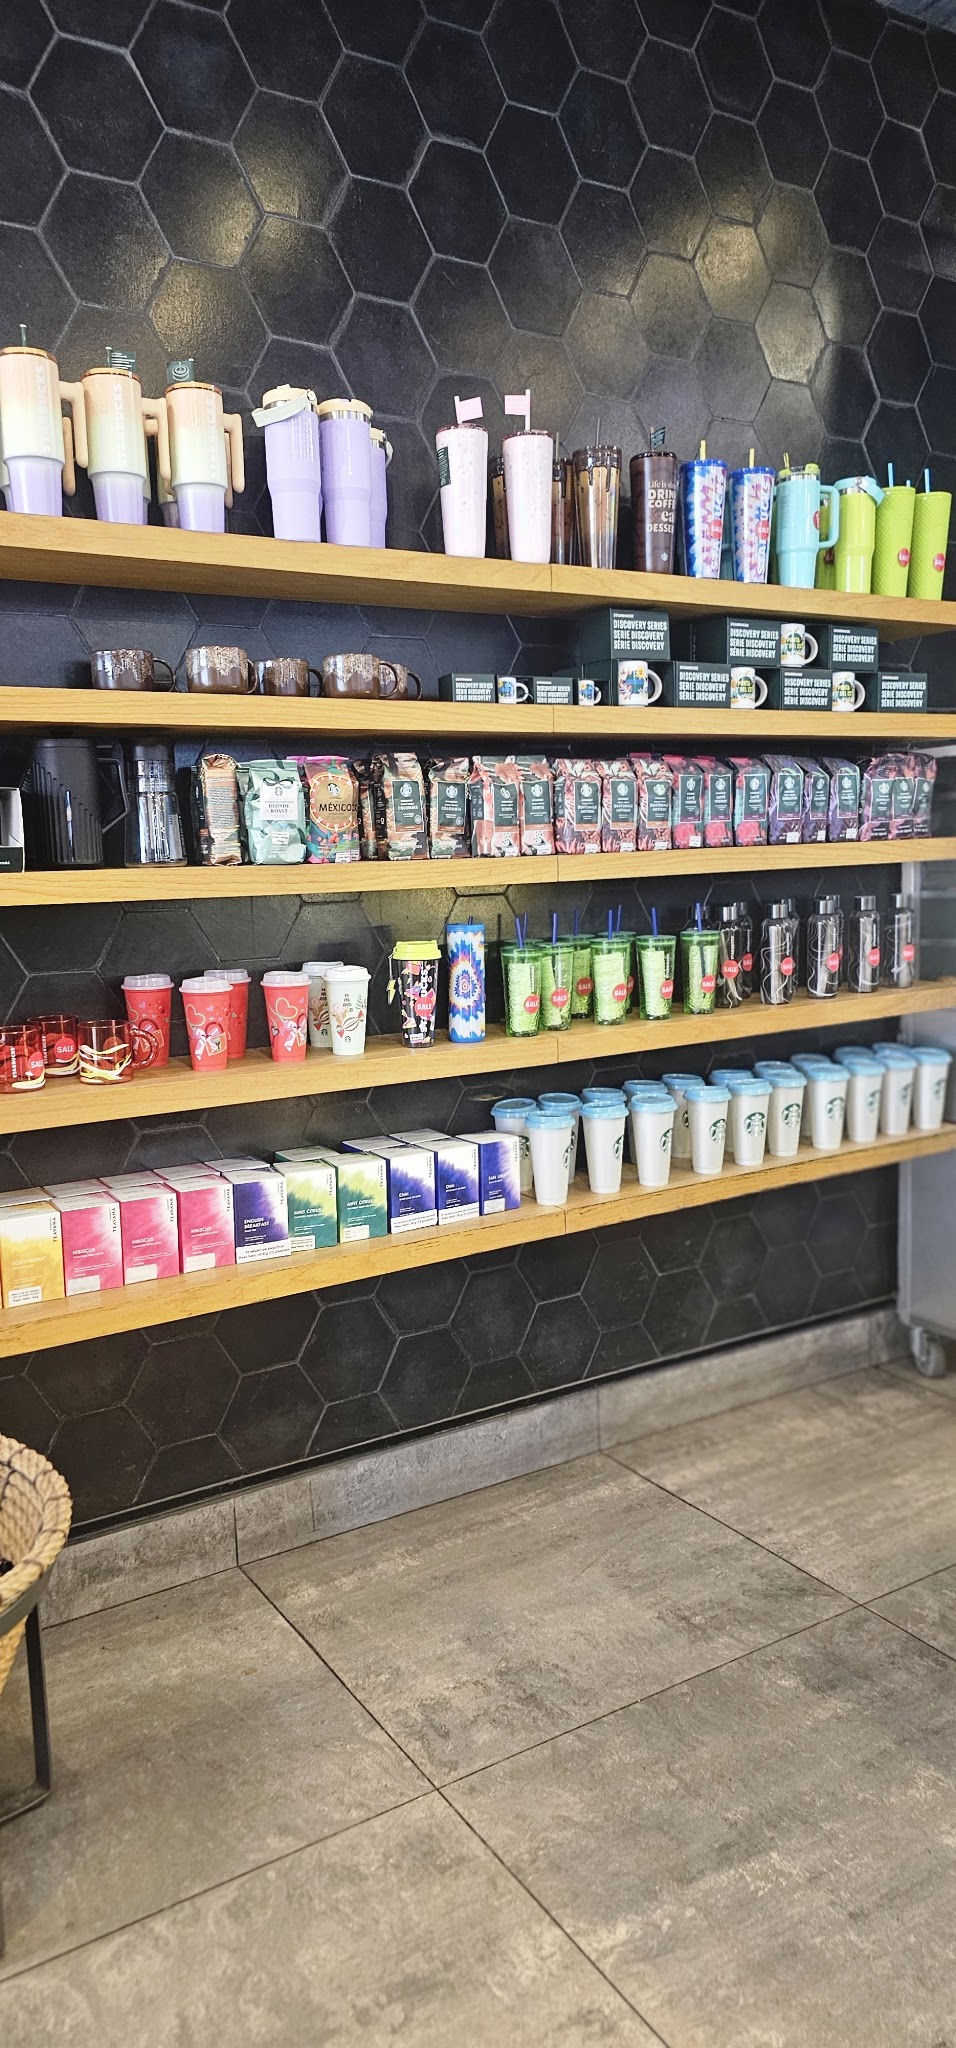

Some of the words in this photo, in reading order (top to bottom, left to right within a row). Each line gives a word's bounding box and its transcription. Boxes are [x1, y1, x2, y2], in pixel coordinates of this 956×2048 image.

[648, 489, 677, 500] DRIN
[613, 620, 646, 630] DISCOVERY
[647, 621, 667, 630] SERIES
[613, 630, 630, 639] SERIE
[631, 630, 664, 640] DISCOVERY
[730, 628, 760, 638] DISCOVERY
[761, 630, 779, 640] SERIES
[746, 639, 776, 649] DISCOVERY
[833, 635, 860, 644] DISCOVERY
[861, 636, 877, 645] SERIES
[631, 641, 664, 650] DISCOVERY
[847, 645, 874, 654] DISCOVERY
[746, 649, 776, 658] DISCOVERY
[847, 654, 874, 663] DISCOVERY
[680, 672, 710, 681] DISCOVERY
[711, 673, 729, 683] SERIES
[696, 682, 726, 691] DISCOVERY
[785, 678, 813, 687] DISCOVERY
[814, 679, 831, 687] SERIES
[881, 681, 909, 690] DISCOVERY
[909, 682, 926, 690] SERIES
[696, 692, 726, 701] DISCOVERY
[800, 688, 828, 696] DISCOVERY
[895, 690, 923, 698] DISCOVERY
[800, 697, 828, 705] DISCOVERY
[895, 699, 923, 707] DISCOVERY
[319, 802, 352, 812] MÉXICO
[419, 969, 428, 1033] STUCKS
[57, 1045, 74, 1053] SALE
[190, 1226, 212, 1234] HIBISCUS
[244, 1221, 270, 1230] BREAKFAST
